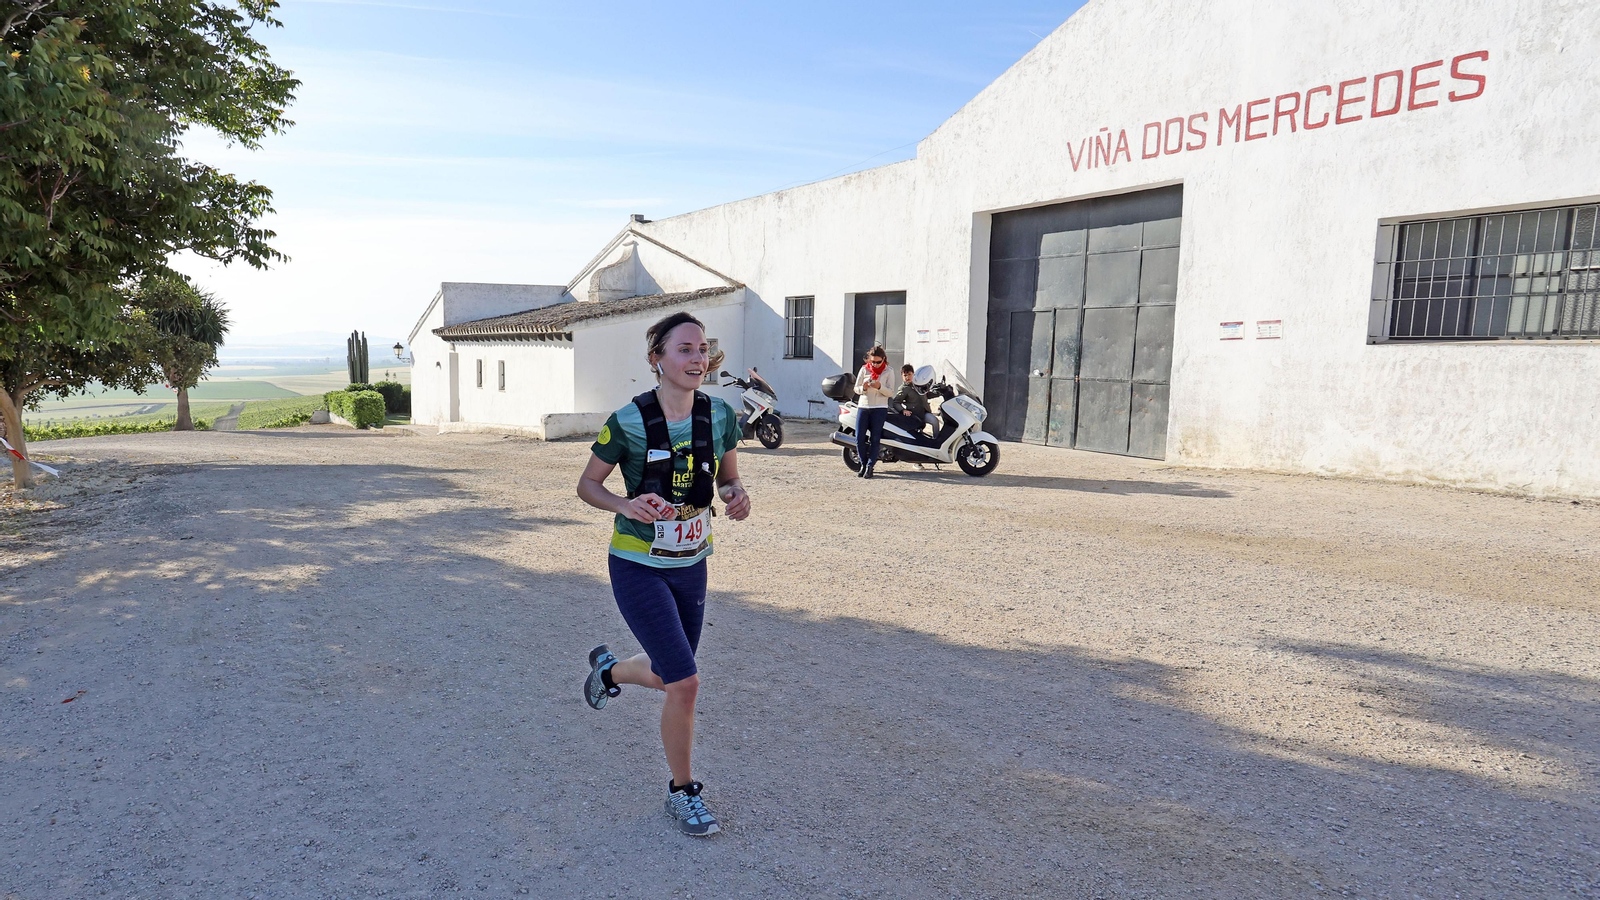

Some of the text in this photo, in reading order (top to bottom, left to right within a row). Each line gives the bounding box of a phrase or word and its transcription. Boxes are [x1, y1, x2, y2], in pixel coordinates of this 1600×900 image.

[1066, 50, 1489, 171] VIÑA DOS MERCEDES
[674, 518, 703, 544] 149
